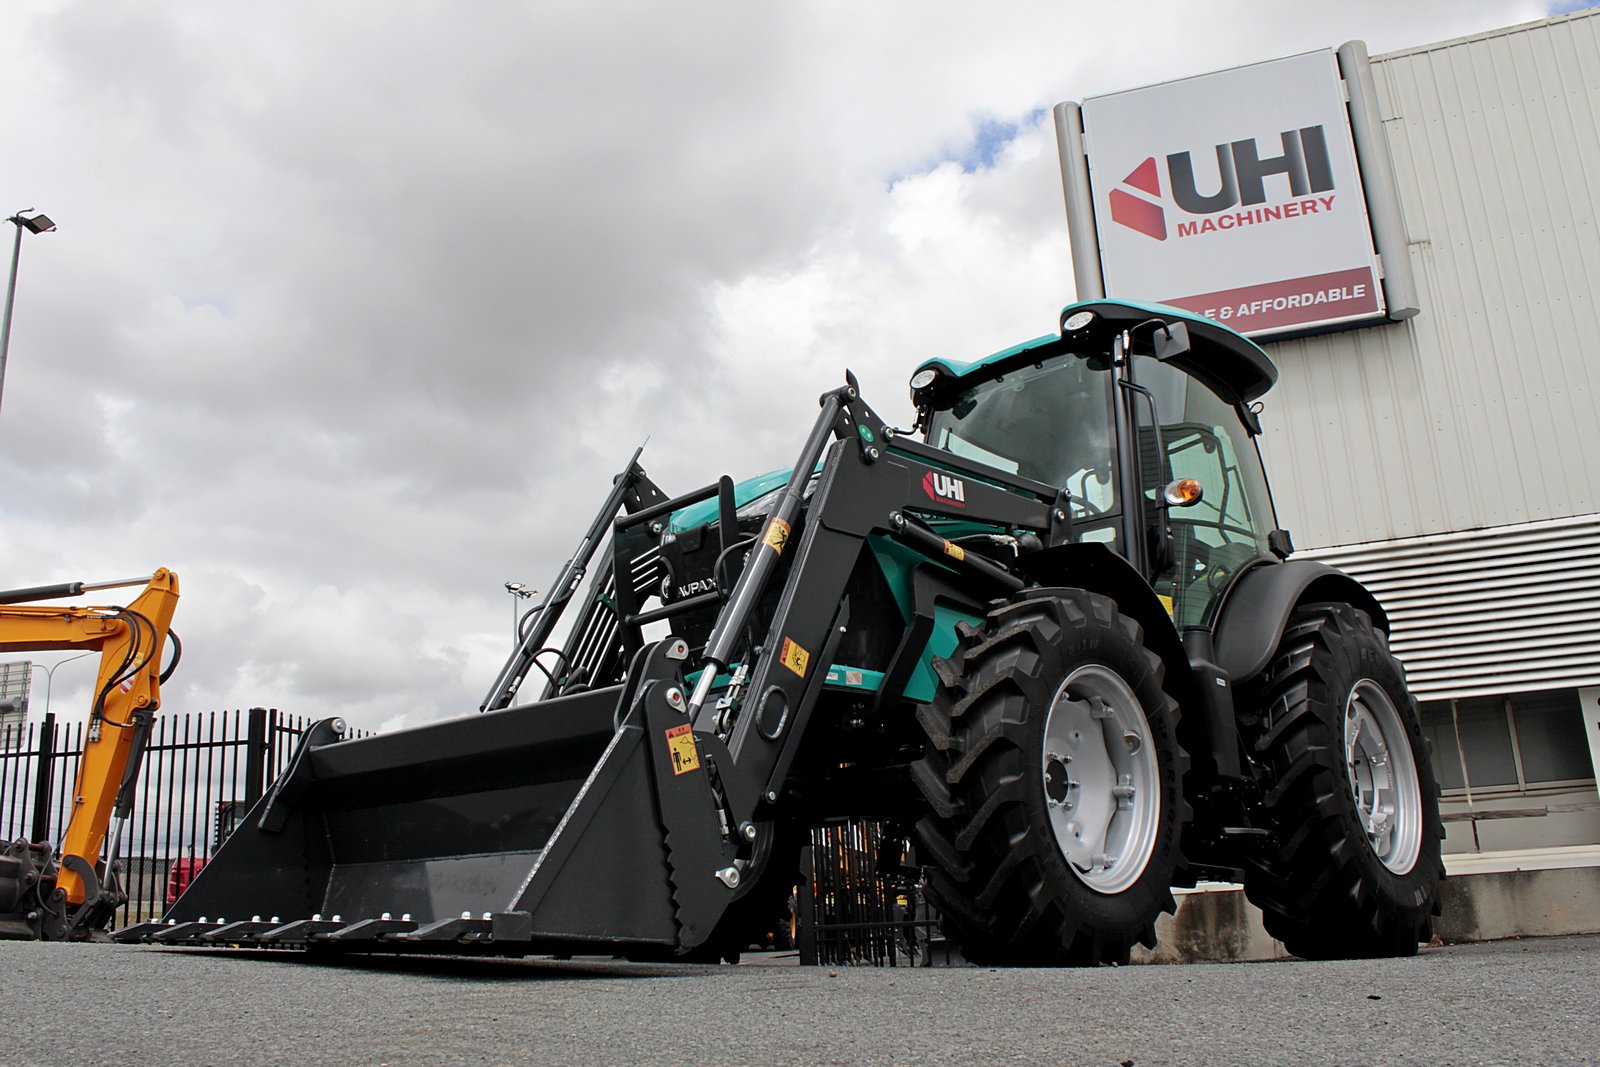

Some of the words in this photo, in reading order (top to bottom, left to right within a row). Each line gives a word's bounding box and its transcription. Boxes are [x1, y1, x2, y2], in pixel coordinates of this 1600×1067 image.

[1166, 124, 1335, 214] UHI
[1177, 195, 1336, 238] MACHINERY
[1219, 306, 1234, 319] &
[1236, 284, 1366, 318] AFFORDABLE
[932, 472, 966, 502] UHI
